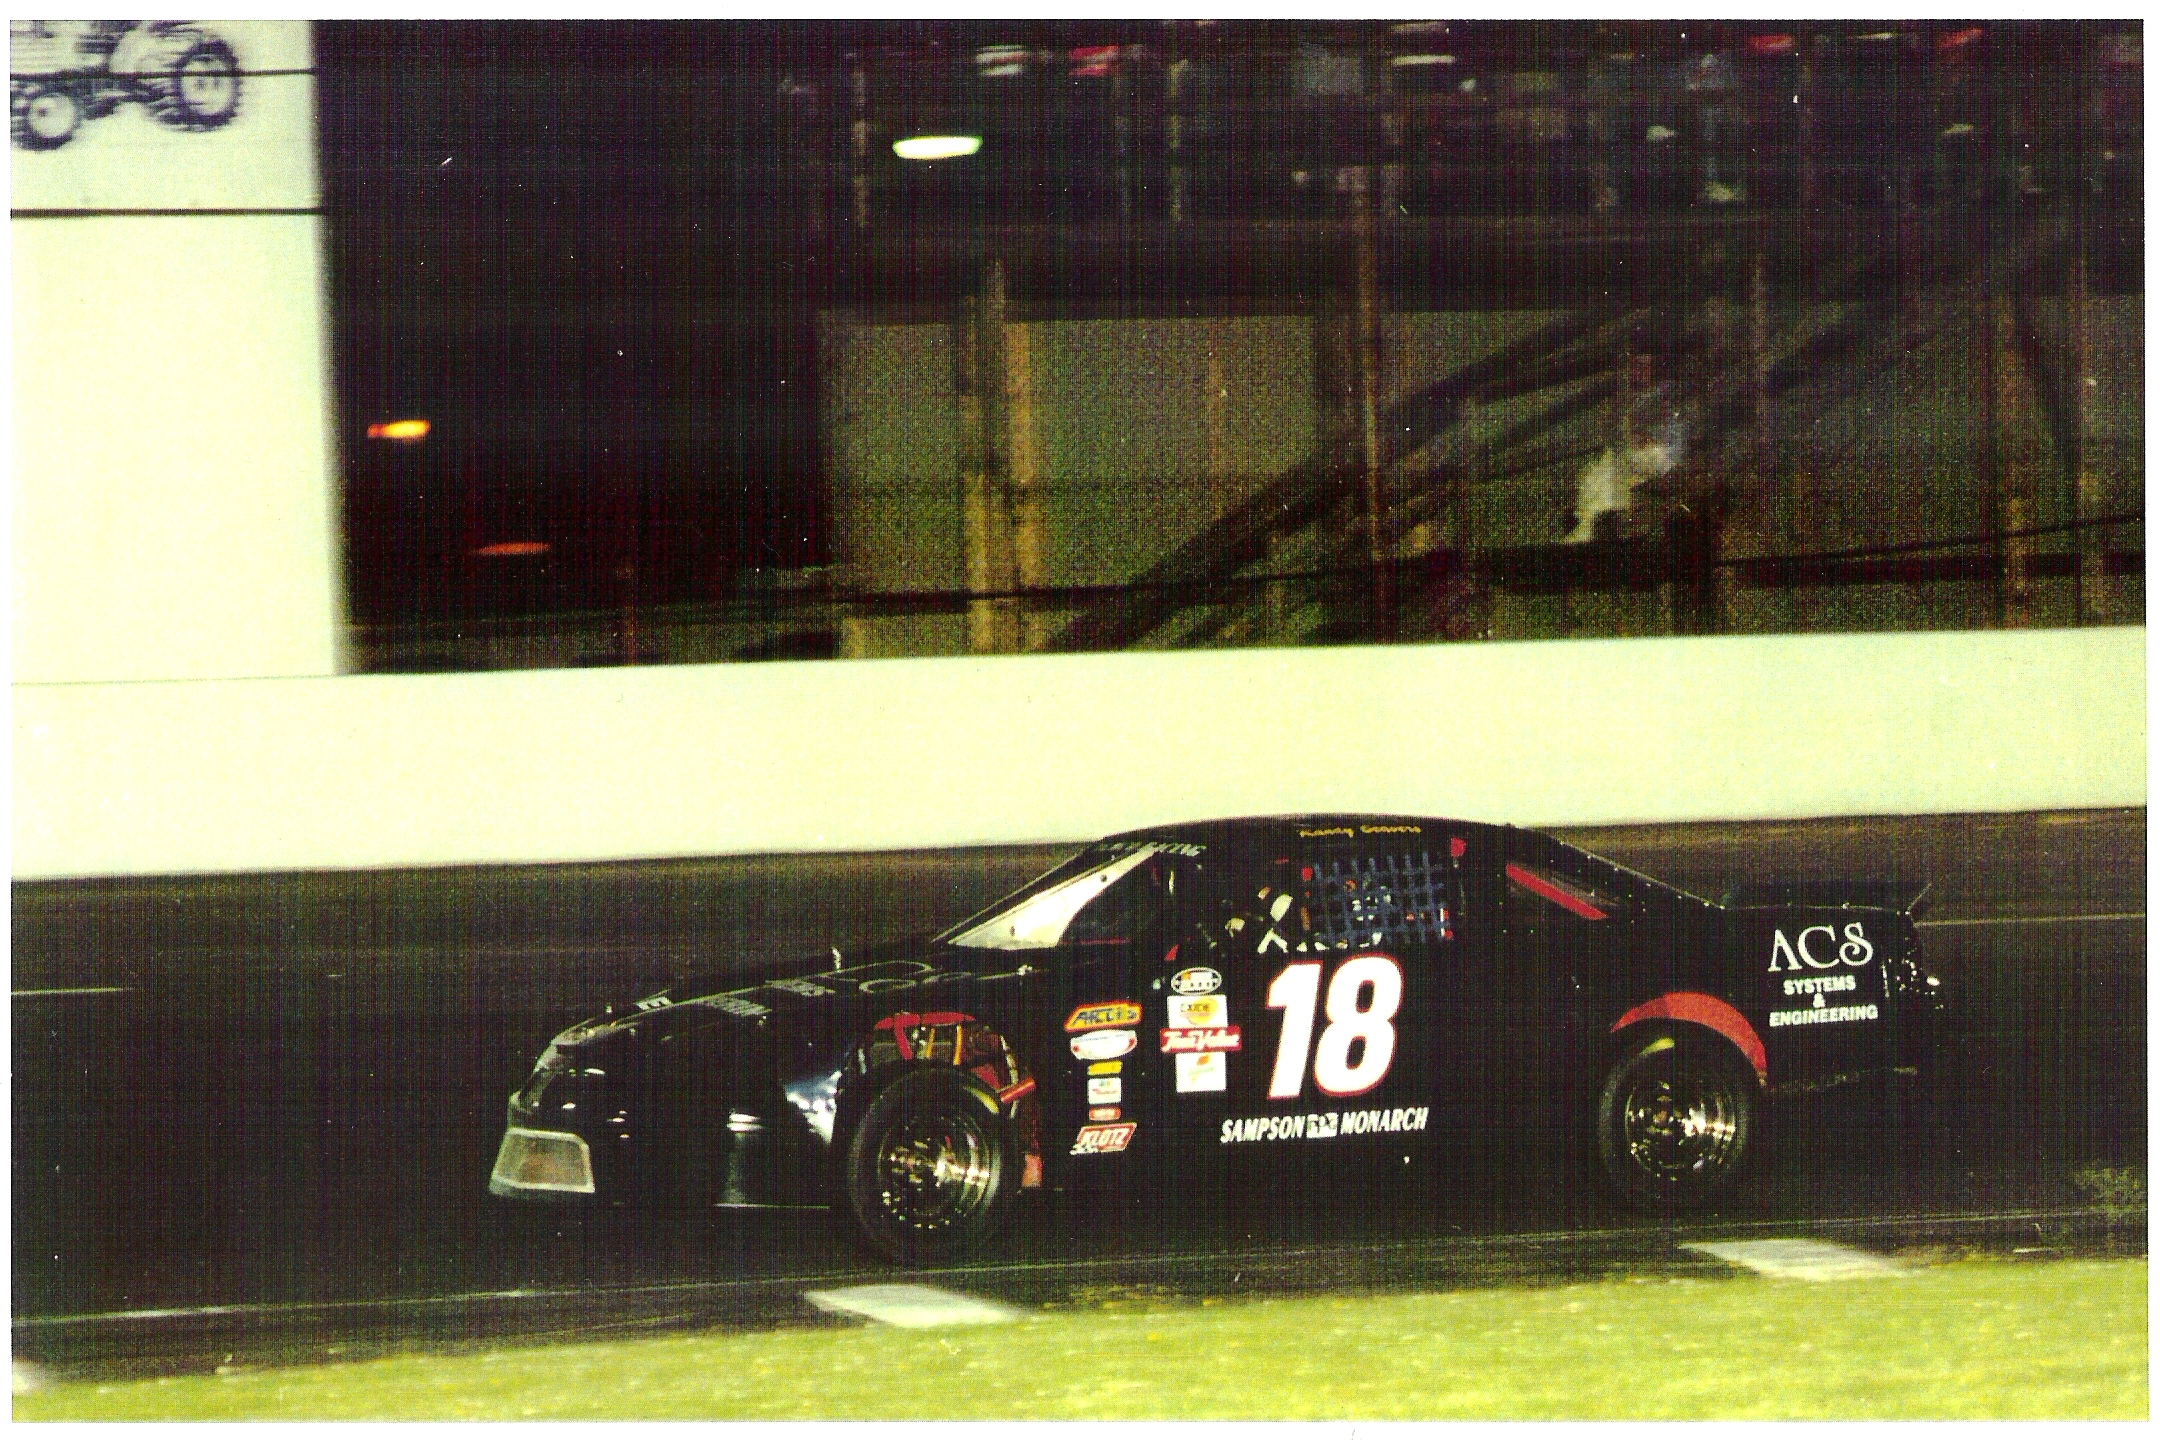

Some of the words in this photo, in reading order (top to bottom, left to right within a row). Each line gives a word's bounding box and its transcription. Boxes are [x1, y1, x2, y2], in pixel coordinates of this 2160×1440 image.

[1768, 922, 1874, 972] ACS
[1783, 975, 1856, 996] SYSTEMS
[1812, 993, 1826, 1008] &
[1266, 953, 1404, 1101] 18
[1769, 1004, 1879, 1028] ENGINEERING
[1220, 1115, 1306, 1143] SAMPSON
[1340, 1107, 1430, 1135] MONARCH
